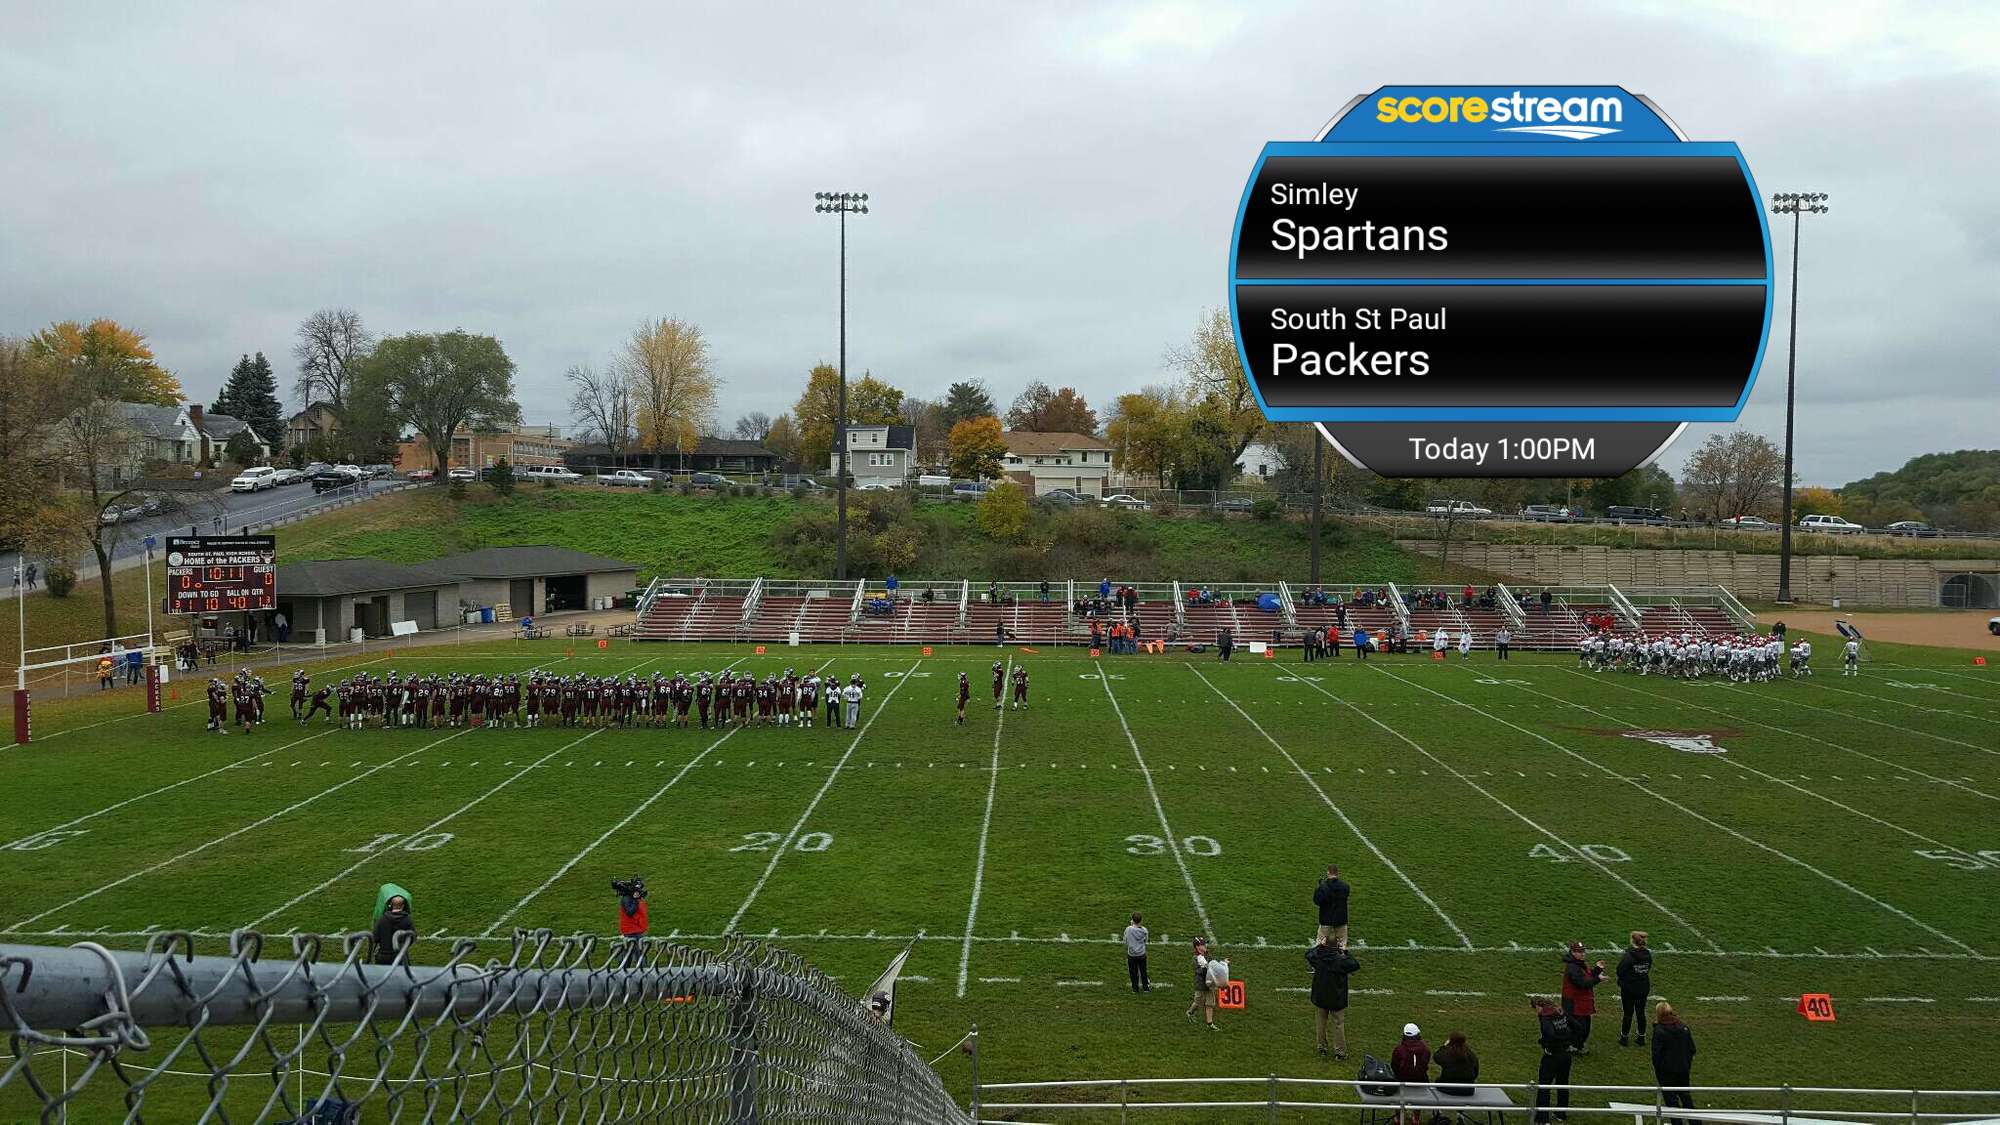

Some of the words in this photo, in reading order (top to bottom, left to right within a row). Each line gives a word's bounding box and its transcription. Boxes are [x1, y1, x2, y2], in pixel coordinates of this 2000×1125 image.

[229, 556, 260, 564] PACKERS
[168, 568, 193, 576] PACKERS
[209, 567, 242, 579] 10:11
[253, 565, 273, 573] GUEST
[182, 576, 190, 588] 0
[264, 573, 272, 585] 0
[210, 590, 219, 598] GO
[206, 598, 218, 610] 10
[229, 596, 246, 609] 40
[728, 832, 834, 851] 20
[1124, 834, 1221, 856] 30
[1528, 844, 1632, 862] 40
[1221, 984, 1242, 1005] 30
[1808, 998, 1831, 1017] 40
